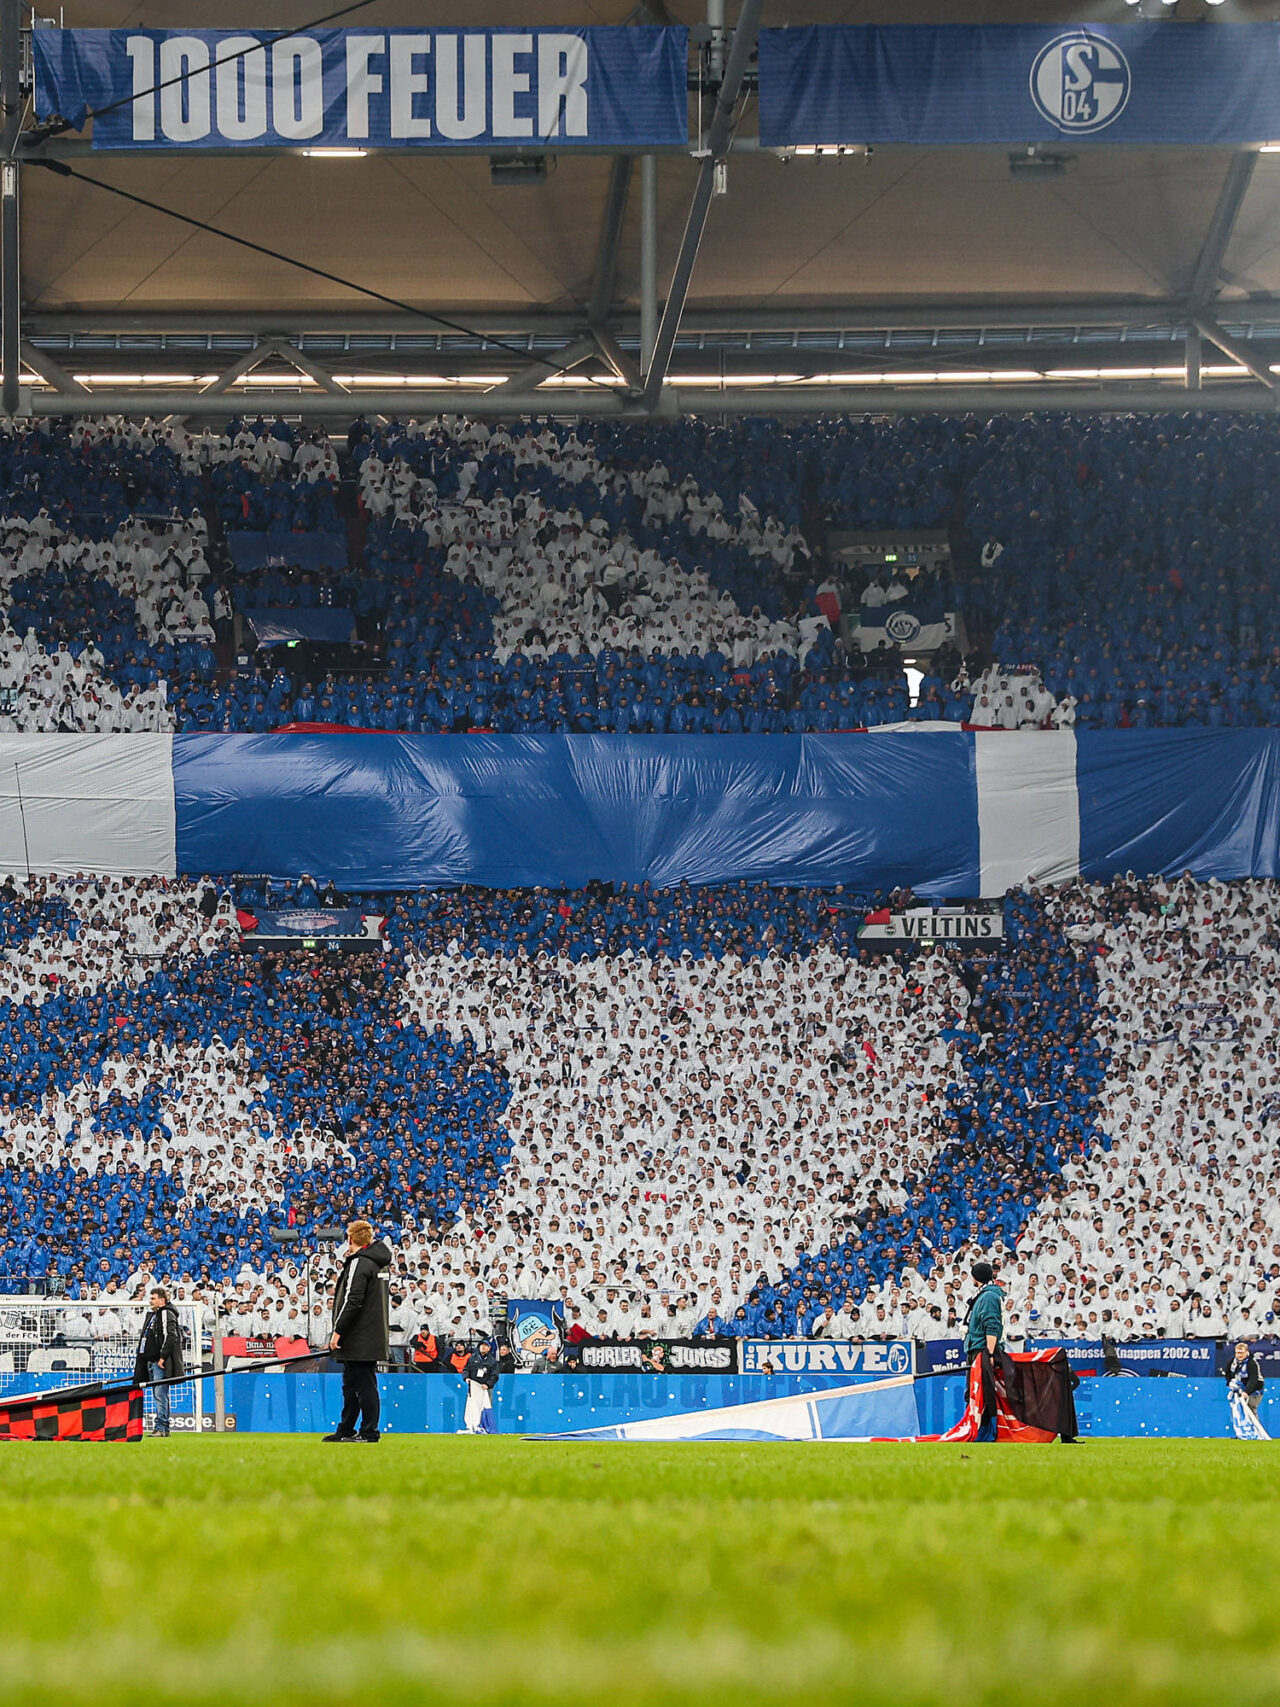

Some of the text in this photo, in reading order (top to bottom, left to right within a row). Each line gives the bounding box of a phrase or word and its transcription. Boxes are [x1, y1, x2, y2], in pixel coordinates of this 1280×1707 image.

[126, 33, 589, 142] 1000 FEUER
[901, 917, 992, 937] VELTINS
[328, 941, 340, 950] N4
[583, 1345, 731, 1368] MARLER JUNGS
[756, 1344, 889, 1371] KURVE
[945, 1349, 959, 1360] SC
[1115, 1348, 1161, 1360] Knappen
[1163, 1347, 1189, 1359] 2002
[1192, 1348, 1210, 1359] e.V.
